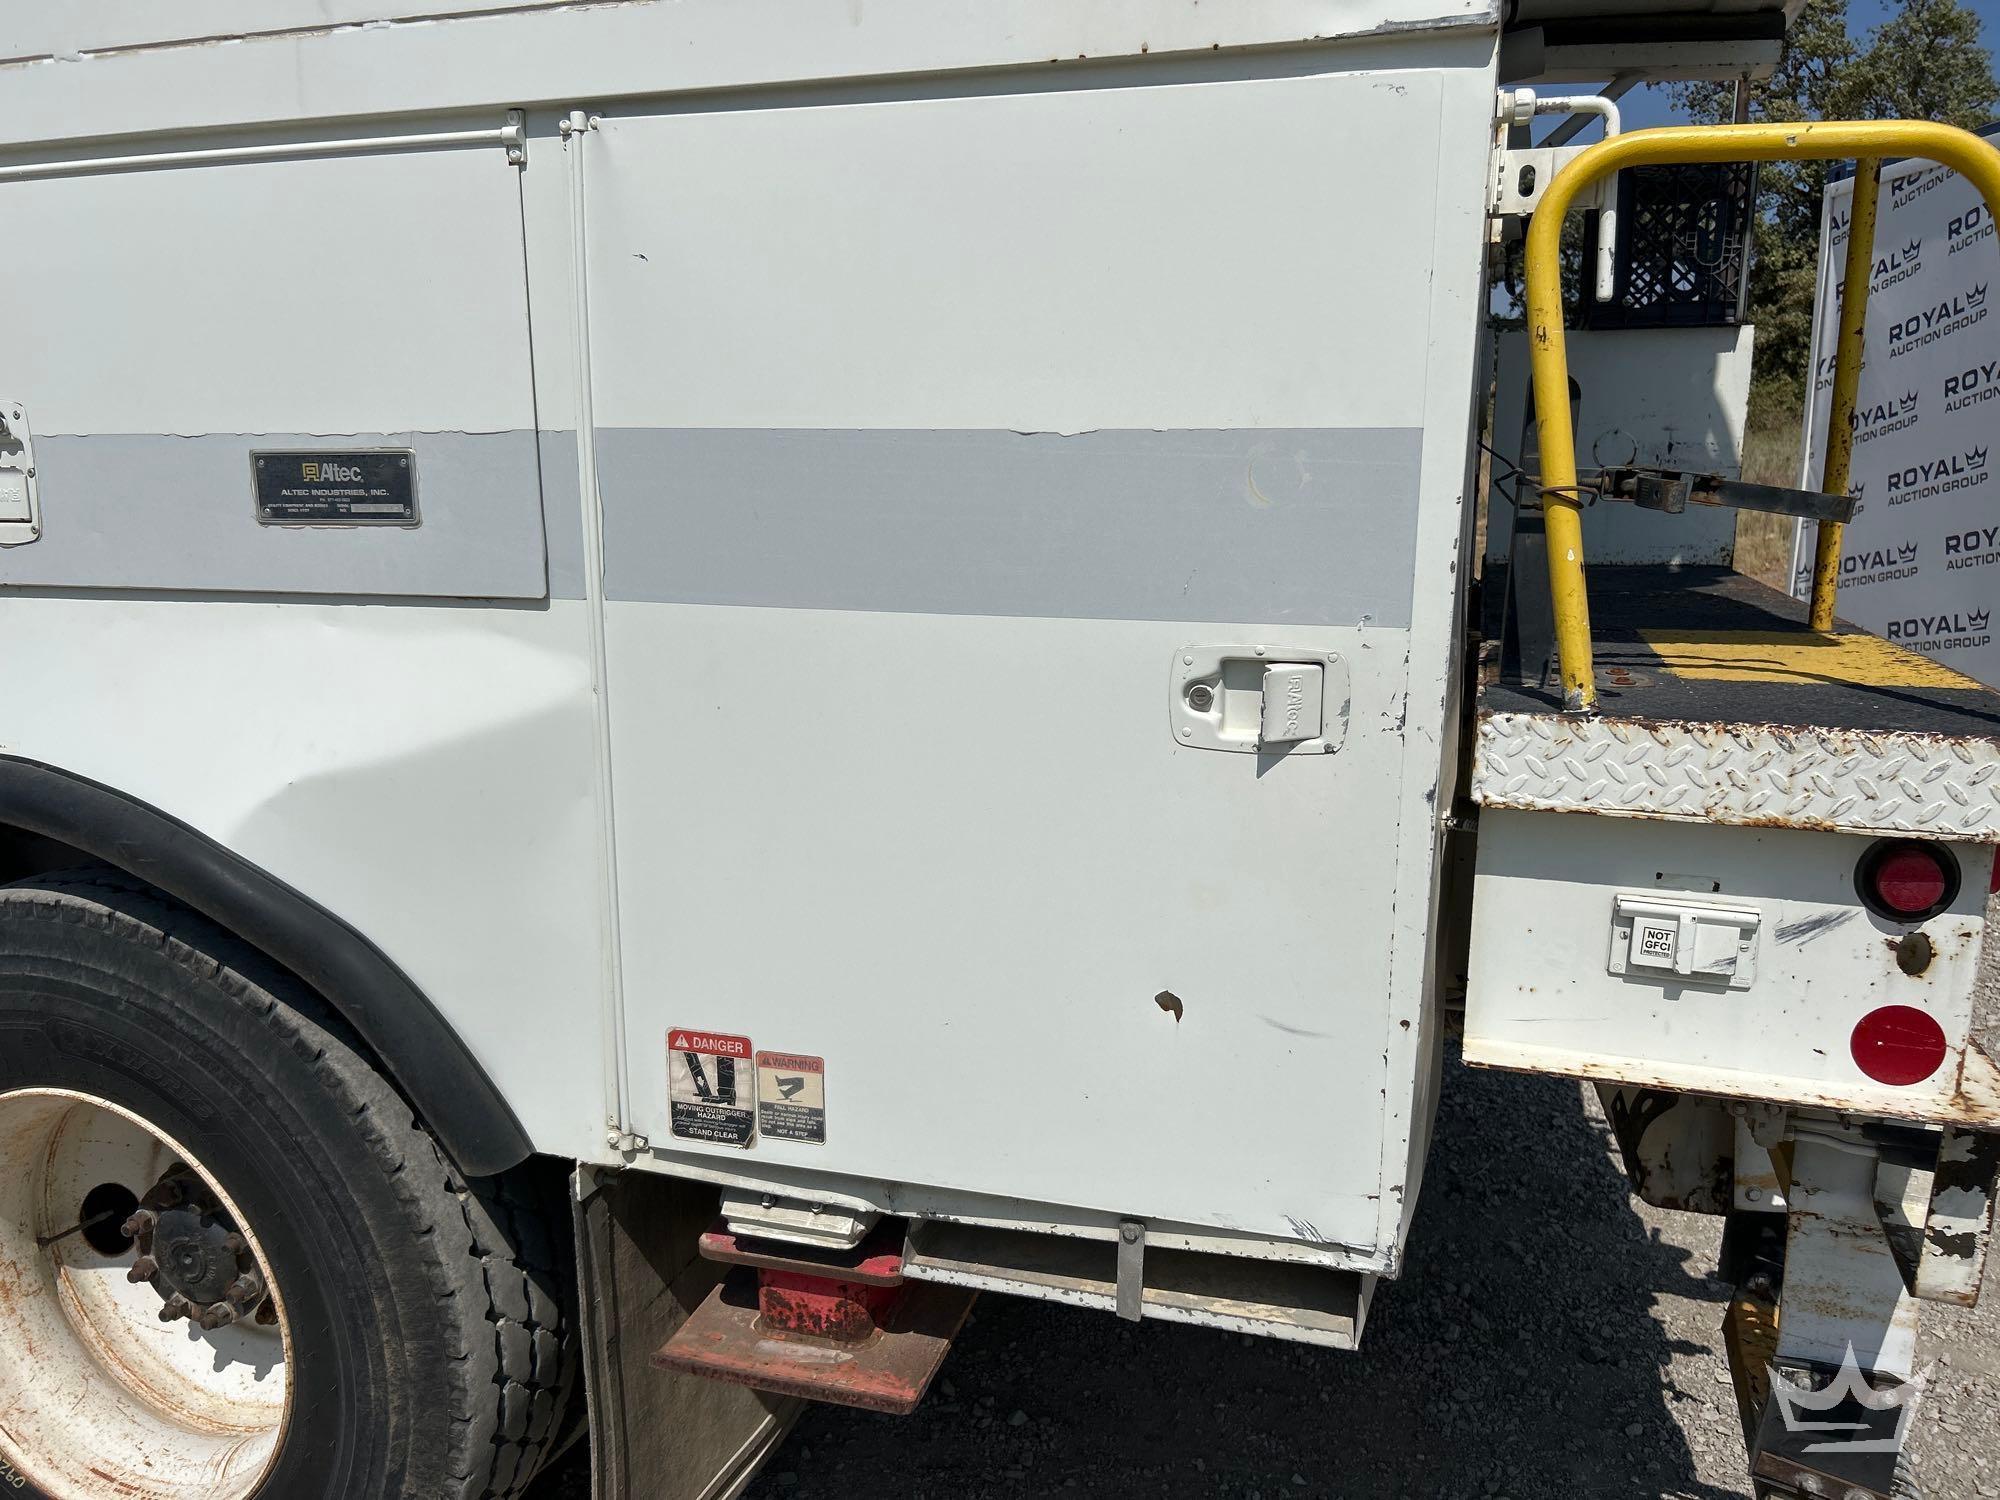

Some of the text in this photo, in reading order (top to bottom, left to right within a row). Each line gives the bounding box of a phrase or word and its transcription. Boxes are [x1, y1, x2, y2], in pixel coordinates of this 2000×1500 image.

[1892, 172, 1944, 211] AUCTION
[1948, 223, 1997, 256] AUCTIO
[1881, 262, 1921, 290] GROUP
[1889, 296, 1965, 345] ROYAL
[1889, 308, 1988, 359] AUCTION GROUP
[1879, 414, 1918, 437] GROUP
[320, 463, 364, 482] Altec
[1888, 456, 1965, 492] ROYAL
[1888, 472, 1989, 507] AUCTION GROUP
[1877, 566, 1918, 582] GROUP
[1887, 614, 1966, 639] ROYAL
[1944, 635, 1990, 649] GROUP
[1645, 940, 1671, 951] GFCI
[1647, 931, 1671, 941] NOT
[693, 1037, 743, 1054] DANGER
[772, 1057, 819, 1071] WARNING
[677, 1103, 746, 1117] MOVING OUTRIGGER
[697, 1112, 726, 1121] HAZARD
[688, 1128, 739, 1140] STAND CLEAR
